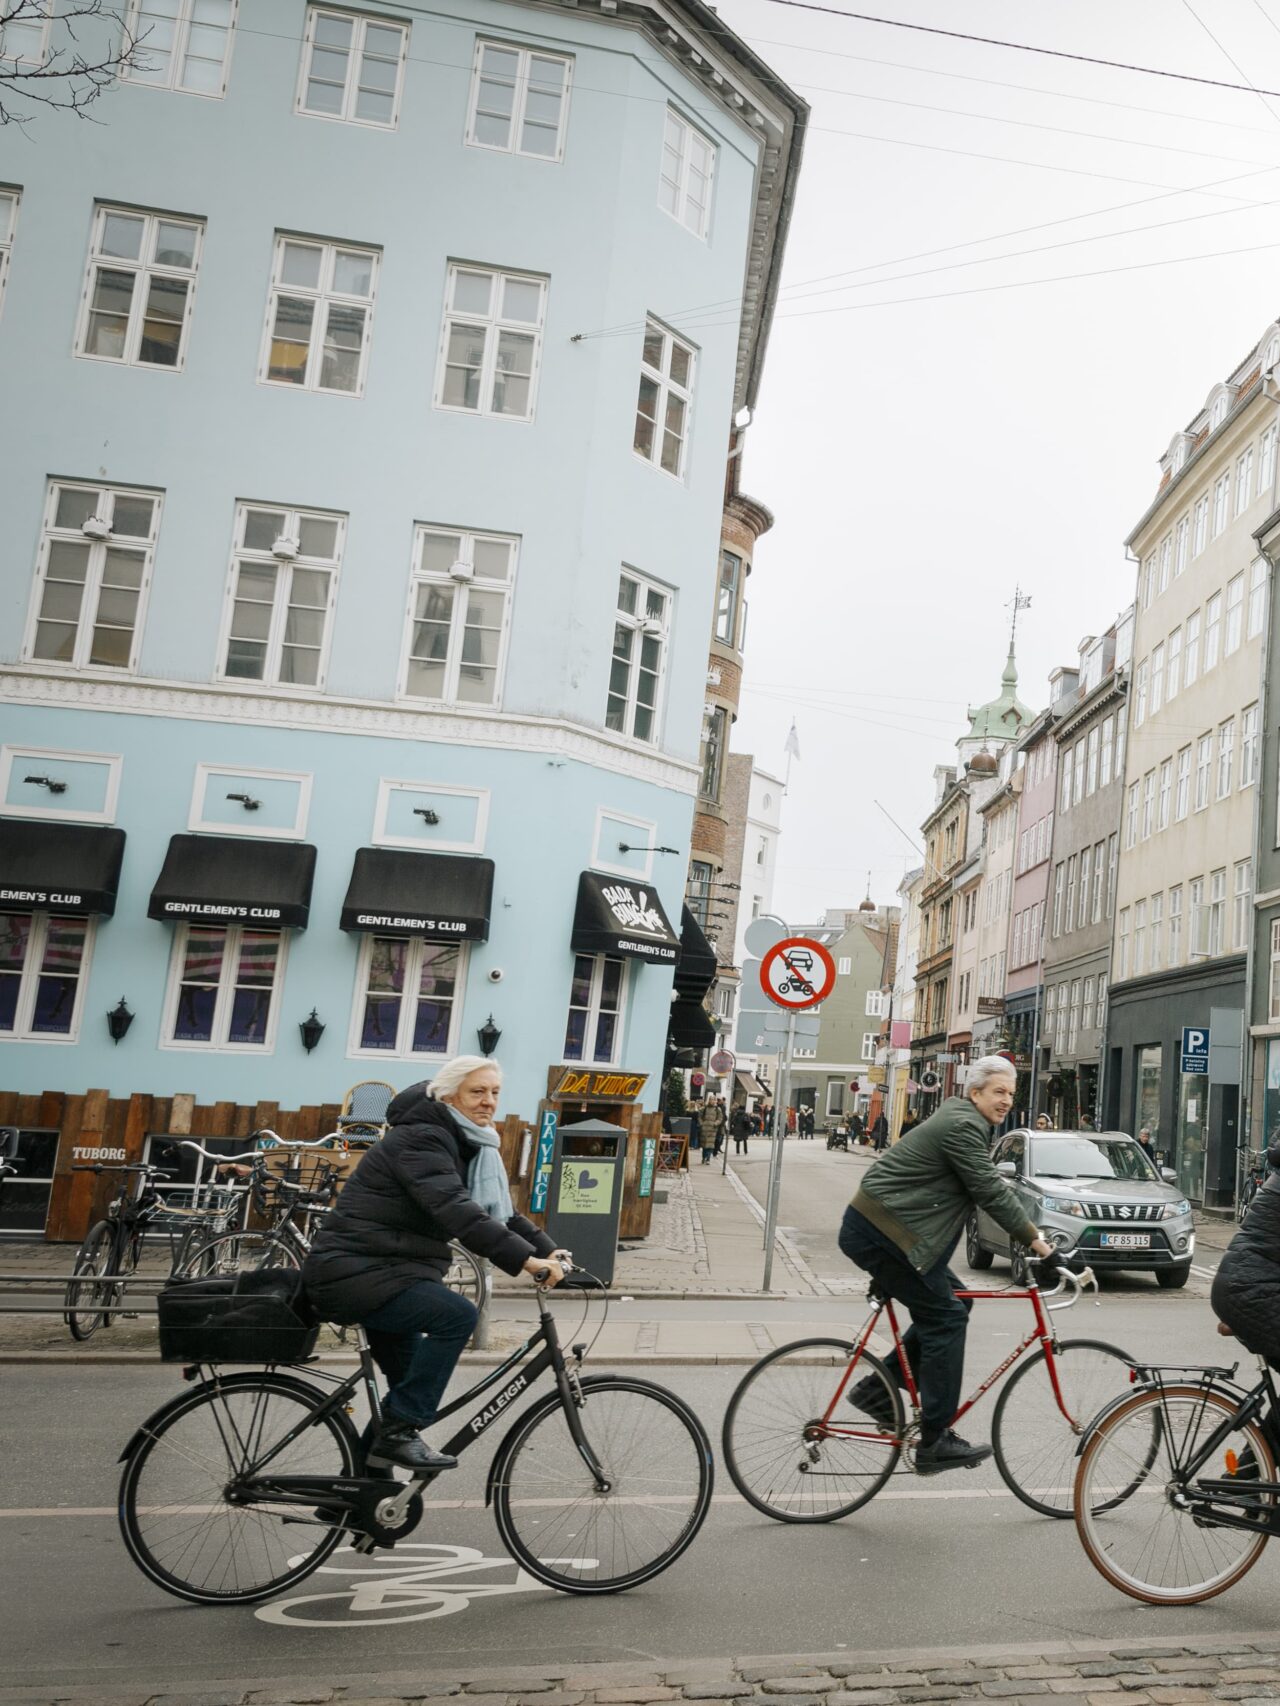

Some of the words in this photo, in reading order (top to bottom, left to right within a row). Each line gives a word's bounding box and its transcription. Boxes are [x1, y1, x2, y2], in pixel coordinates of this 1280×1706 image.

[50, 893, 82, 904] CLUB
[602, 886, 635, 906] BADA
[164, 902, 248, 916] GENTLEMEN'S
[250, 908, 281, 918] CLUB
[357, 914, 436, 929] GENTLEMEN'S
[438, 921, 467, 932] CLUB
[618, 940, 660, 955] GENTLEMEN'S
[660, 948, 676, 958] CLUB
[1188, 1031, 1204, 1053] P
[561, 1073, 590, 1093] DA
[592, 1076, 646, 1096] VINCI
[73, 1147, 126, 1161] TUBORG
[1107, 1235, 1118, 1244] CF
[1121, 1236, 1131, 1245] 85
[1134, 1237, 1149, 1245] 115
[470, 1375, 527, 1433] RALEIGH
